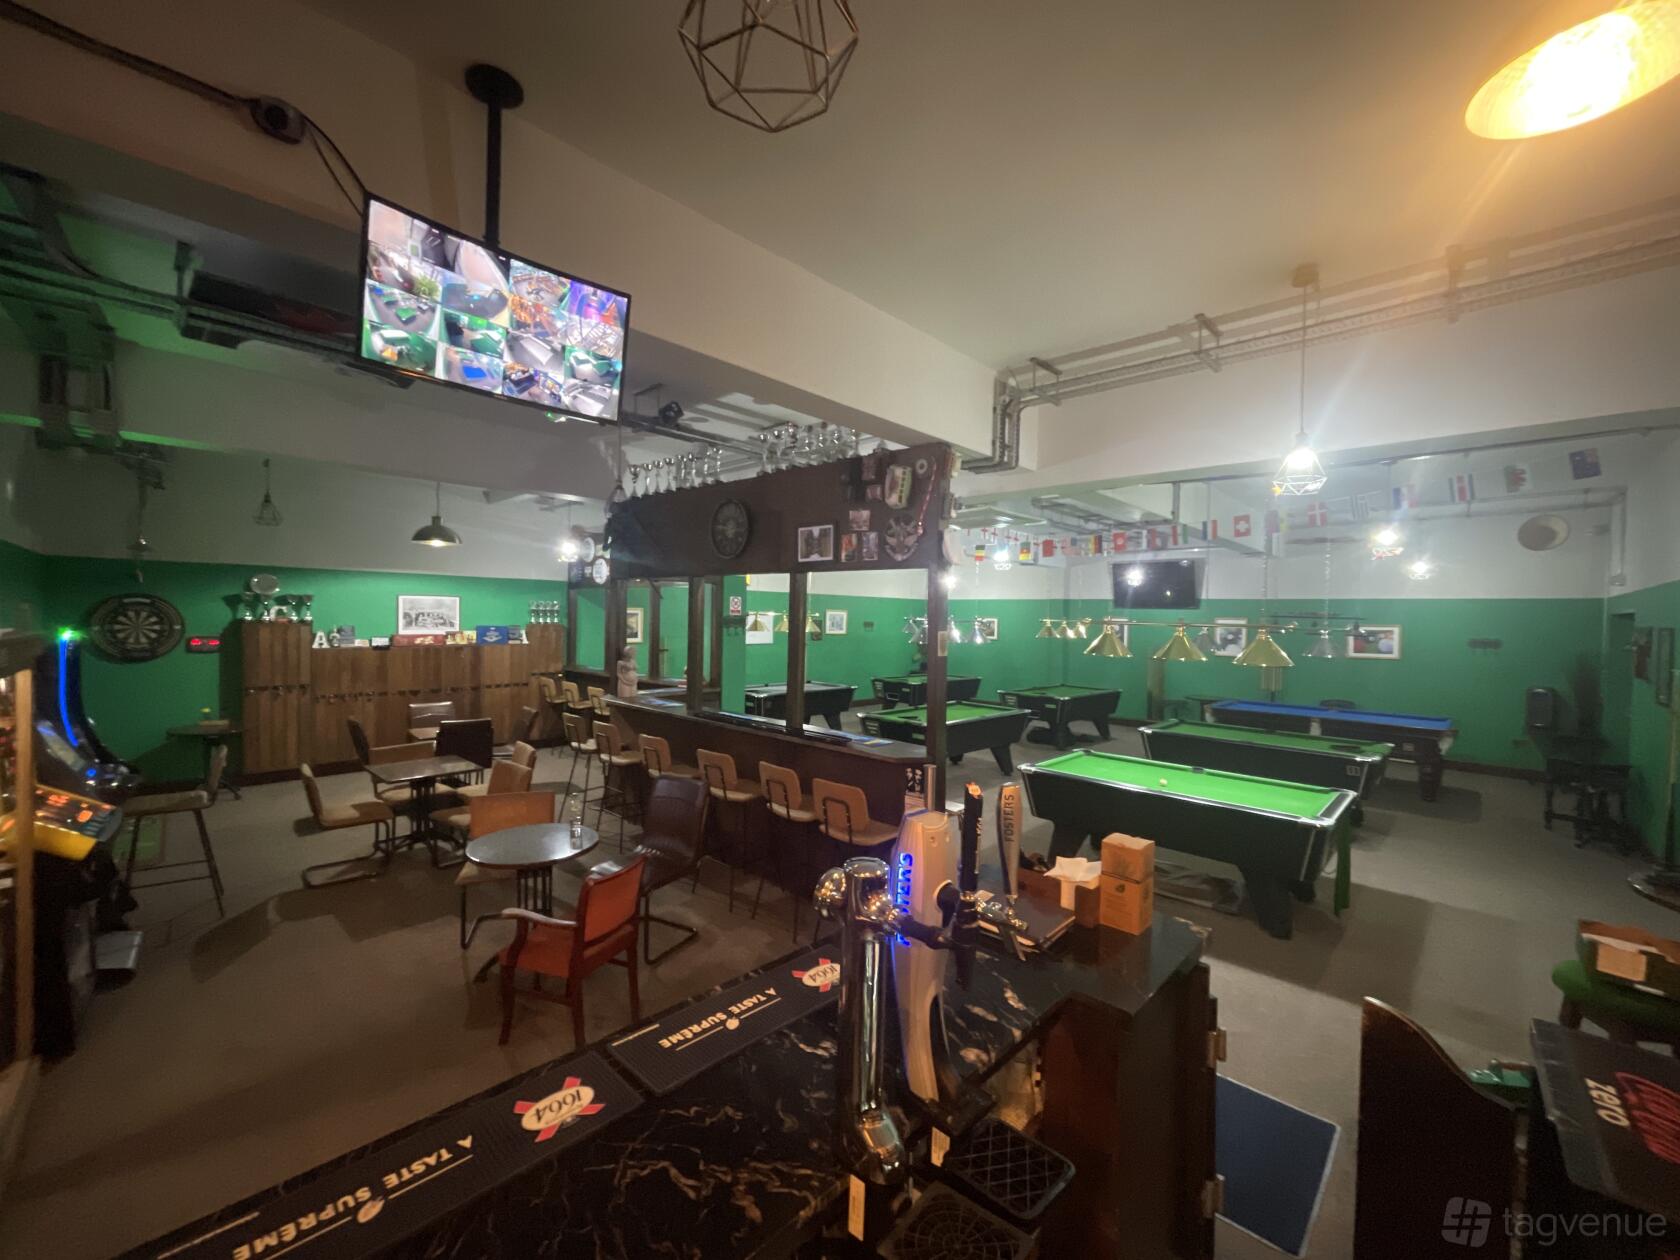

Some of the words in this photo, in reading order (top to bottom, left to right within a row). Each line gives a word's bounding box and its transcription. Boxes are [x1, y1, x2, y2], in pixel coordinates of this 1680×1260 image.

[1003, 794, 1015, 842] FOSTERS
[728, 993, 768, 1015] TASTE
[764, 987, 778, 996] A
[658, 1011, 727, 1049] SUPRÊME
[534, 1089, 582, 1122] 1664
[1584, 1077, 1631, 1128] zero
[456, 1134, 474, 1150] A
[382, 1147, 453, 1190] TASTE
[232, 1185, 372, 1260] SUPRÊME
